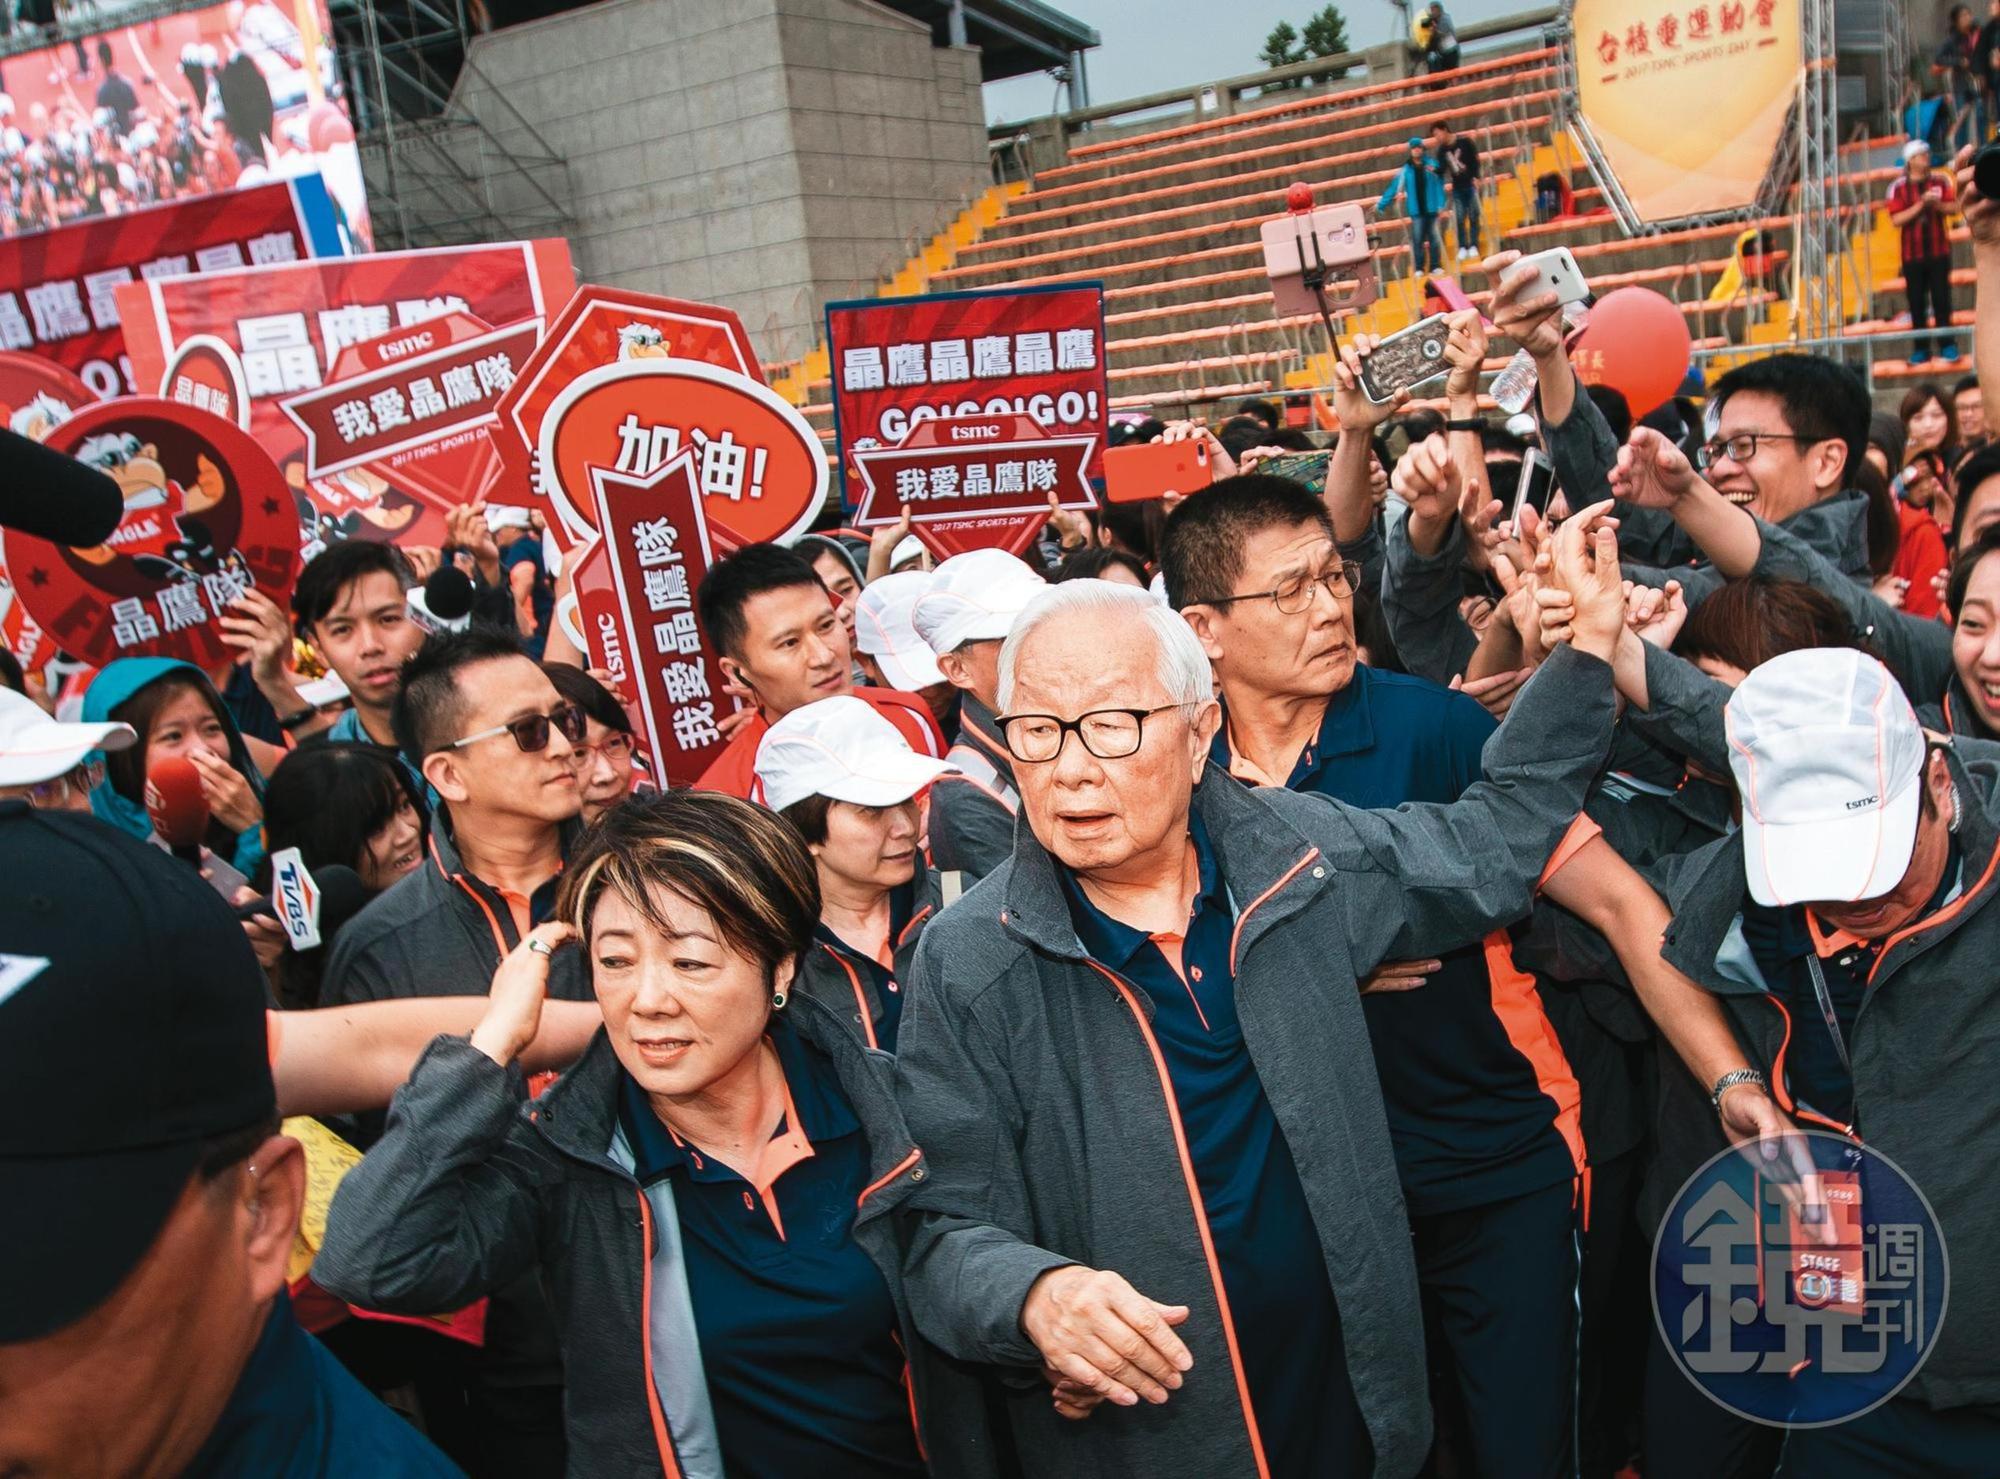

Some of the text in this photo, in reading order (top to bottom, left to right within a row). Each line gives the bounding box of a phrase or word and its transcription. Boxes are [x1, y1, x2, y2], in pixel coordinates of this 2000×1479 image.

[1597, 0, 1776, 65] 台積電運動會
[378, 331, 435, 361] tsmc
[843, 328, 1097, 392] 晶鷹晶鷹晶鷹
[332, 352, 517, 443] 我愛晶鷹隊
[614, 415, 768, 501] 加油!
[951, 424, 1000, 440] tsmc
[896, 458, 1058, 502] 我愛晶鷹隊
[932, 516, 1027, 532] 2017 TSMC SPORTS DAY
[111, 564, 247, 648] 晶鷹隊
[631, 515, 720, 751] 我愛晶鷹隊
[596, 612, 627, 683] tsmc
[1846, 795, 1879, 810] tsmc
[280, 861, 310, 938] TVBS
[1800, 1253, 1840, 1271] STAFF
